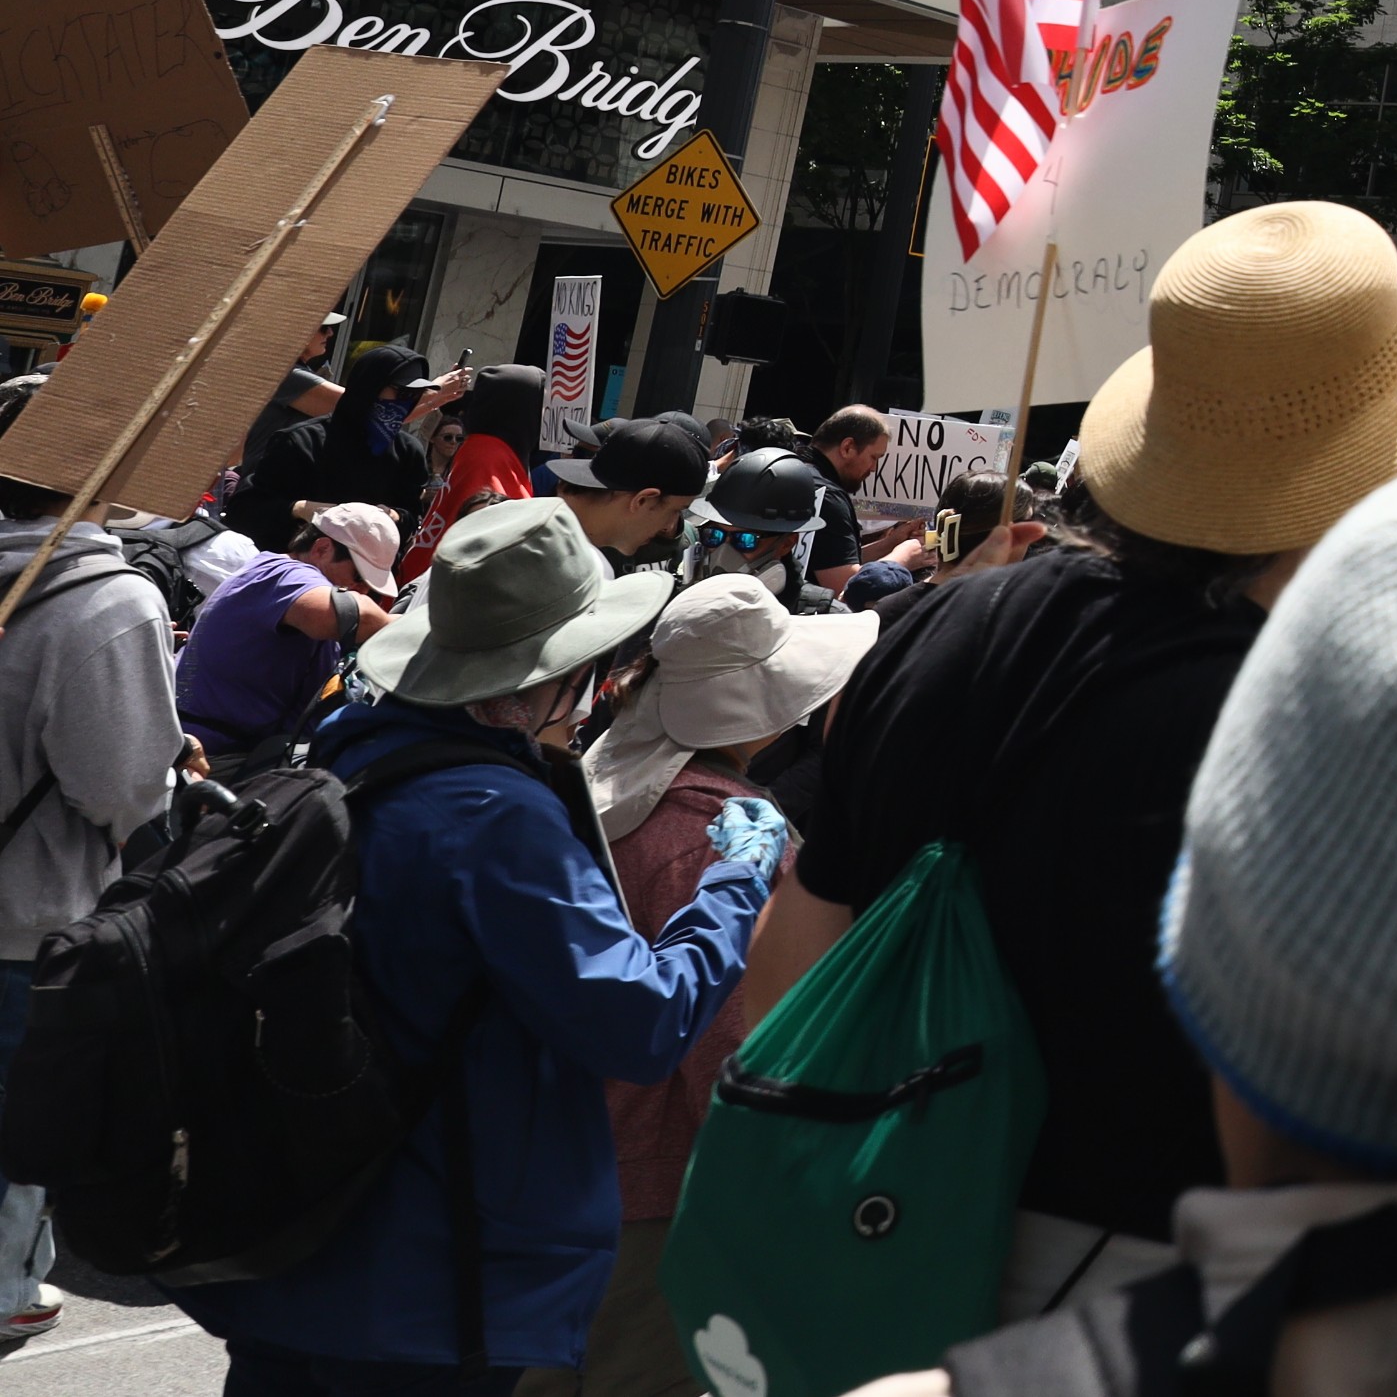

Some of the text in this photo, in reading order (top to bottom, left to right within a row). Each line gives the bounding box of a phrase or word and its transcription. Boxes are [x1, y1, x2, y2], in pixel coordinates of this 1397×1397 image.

[1048, 15, 1174, 116] RIDE
[666, 164, 721, 190] BIKES
[626, 193, 744, 228] MERGE WITH
[640, 229, 715, 259] TRAFFIC
[26, 286, 75, 313] Bridge
[554, 280, 598, 317] NO KINGS
[897, 419, 945, 451] NO
[852, 452, 987, 501] KKIN
